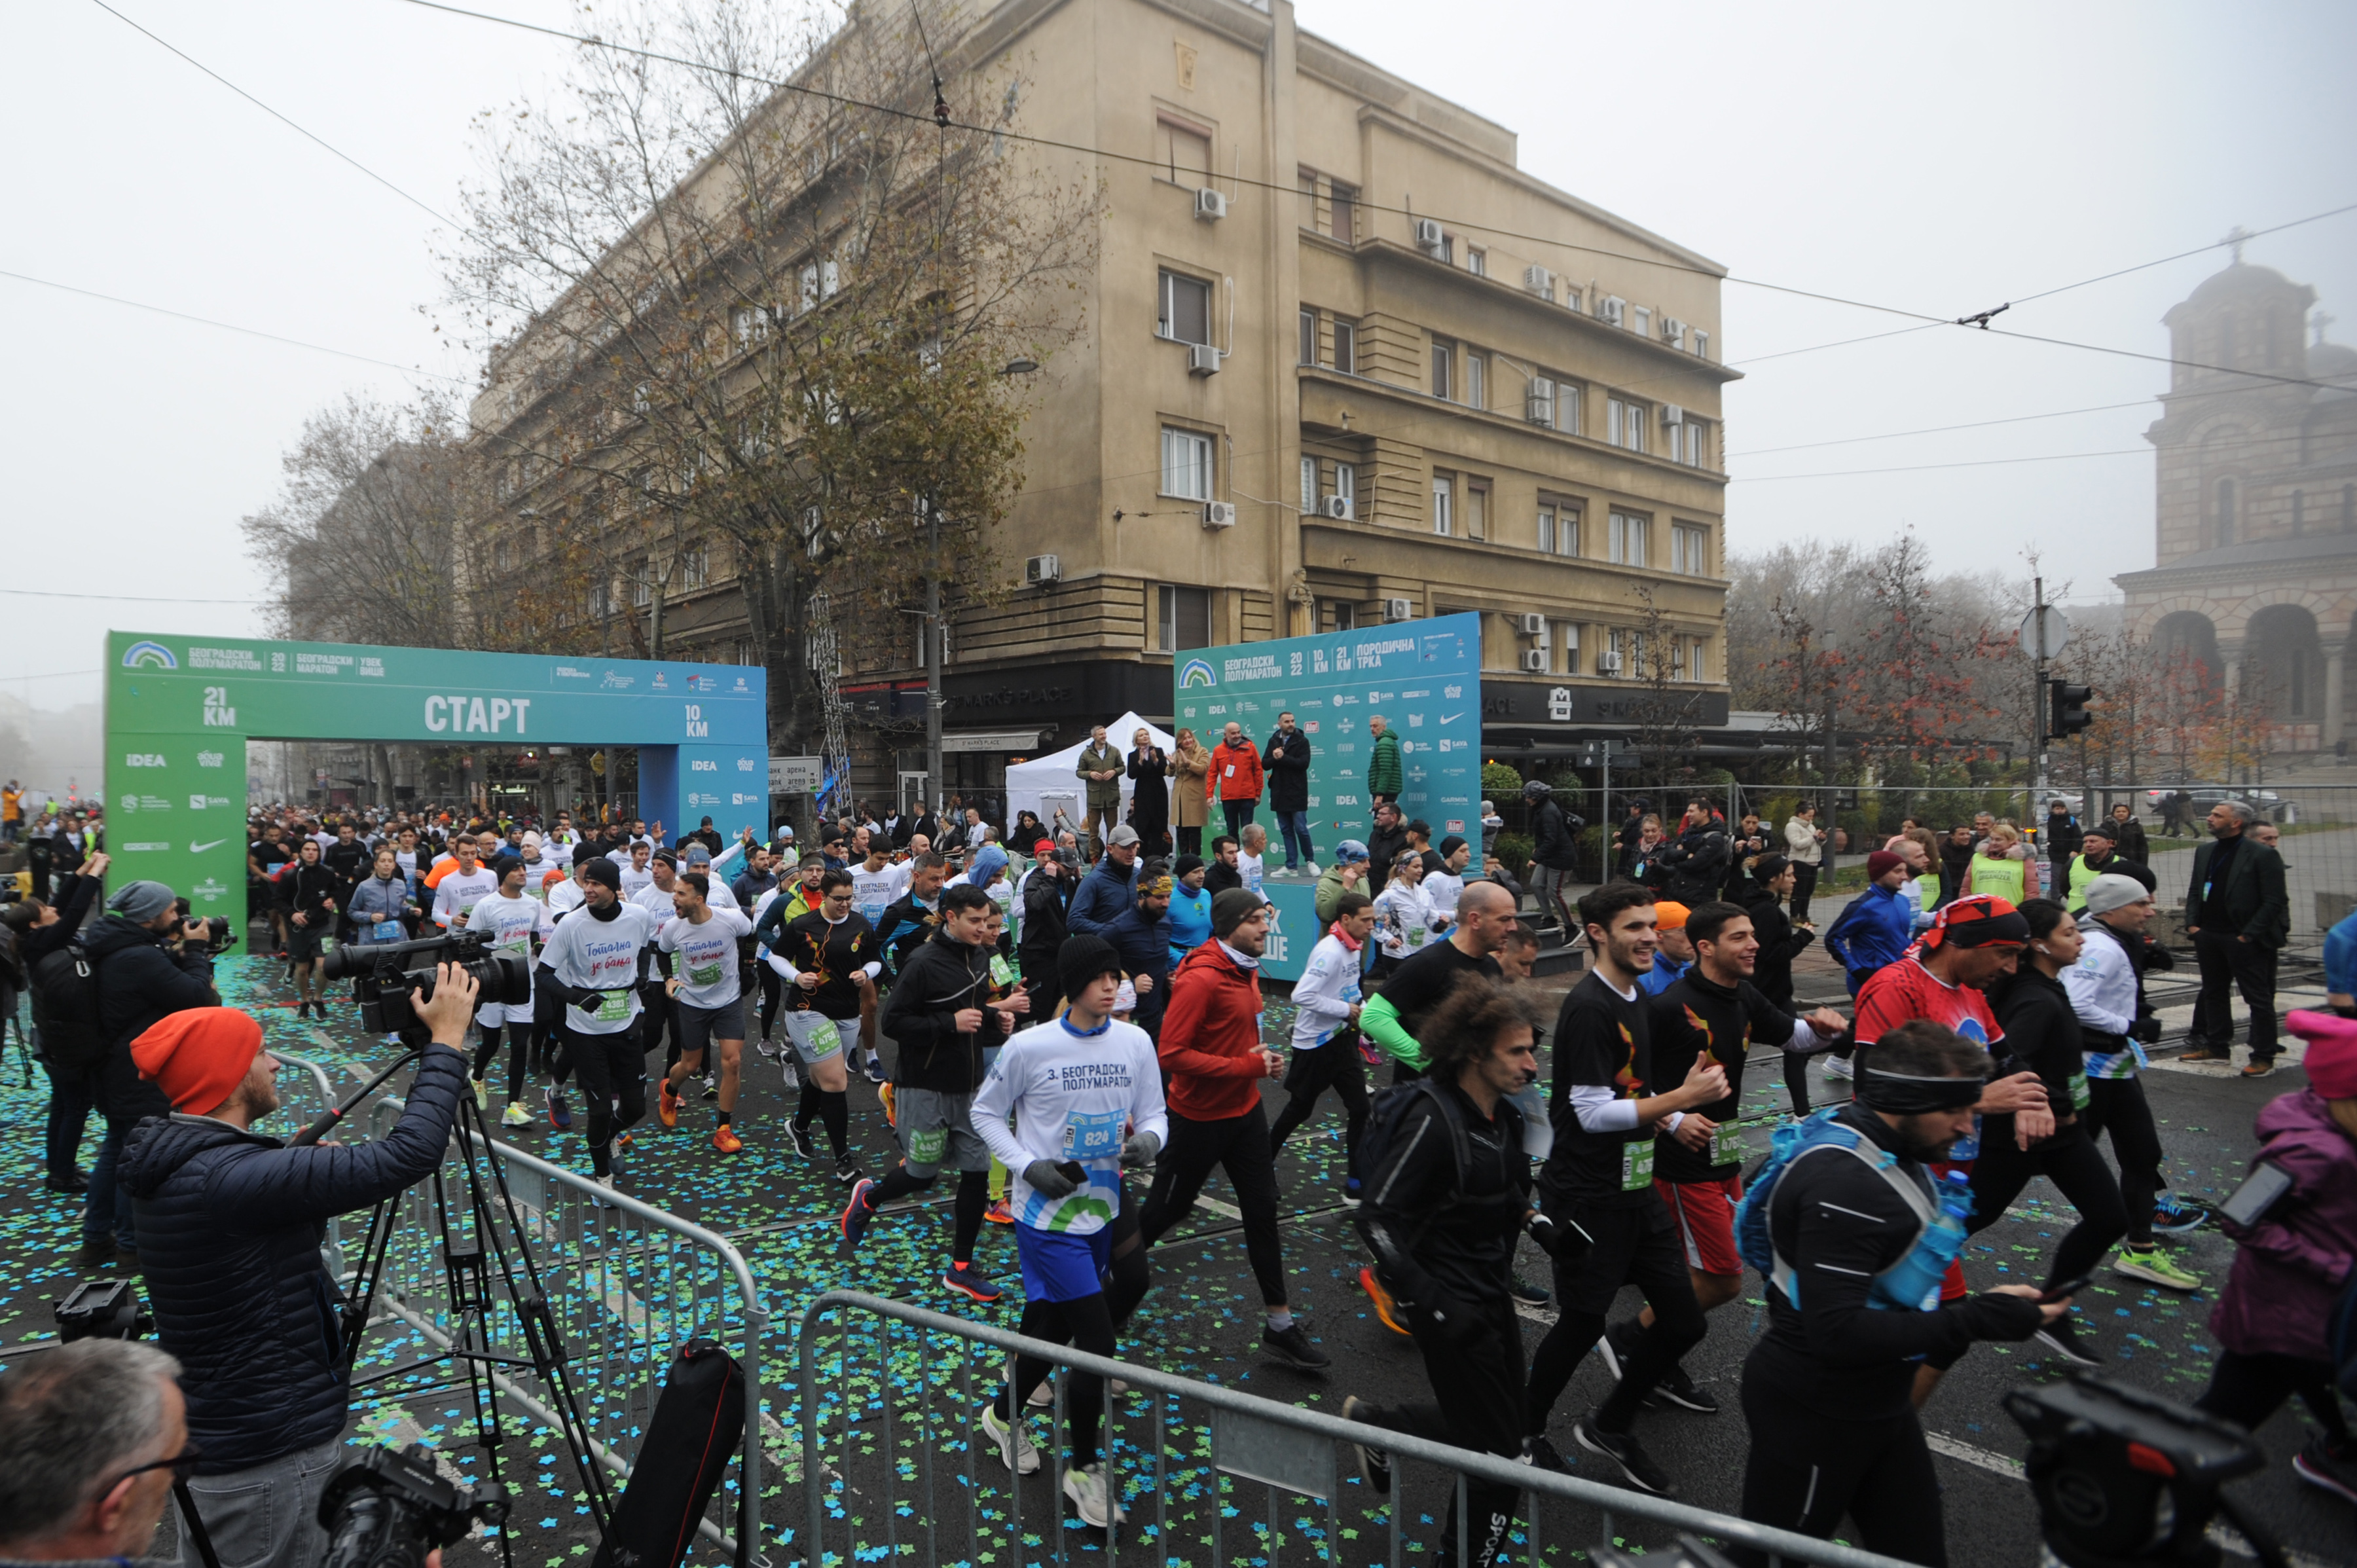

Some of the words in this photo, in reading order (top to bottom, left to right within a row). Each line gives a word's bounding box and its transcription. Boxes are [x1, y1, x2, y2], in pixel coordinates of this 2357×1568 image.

[189, 647, 254, 660] БЕОГРАДСКИ
[1337, 646, 1347, 659] 21
[1357, 638, 1415, 657] ПОРОДИЧНА
[271, 652, 285, 662] 20
[296, 653, 353, 665] БЕОГРАДСКИ
[359, 657, 382, 666] УВЕК
[1290, 652, 1303, 664] 20
[1313, 649, 1323, 661] 10
[189, 657, 261, 670] ПОЛУМАРАТОН
[271, 662, 285, 672] 22
[296, 663, 338, 674] МАРАТОН
[1225, 655, 1274, 670] БЕОГРАДСКИ
[1357, 655, 1382, 669] ТРКА
[359, 666, 384, 676] ВИШЕ
[1225, 666, 1282, 682] ПОЛУМАРАТОН
[1291, 664, 1303, 676] 22
[204, 687, 227, 706] 21
[1019, 687, 1074, 703] PLACE
[425, 695, 530, 733] СТАРТ
[685, 704, 701, 720] 10
[591, 960, 601, 976] је
[604, 956, 630, 969] бања
[606, 998, 625, 1009] 4383
[818, 1030, 836, 1046] 4758
[1048, 1069, 1059, 1080] 3.
[1062, 1064, 1126, 1079] БЕОГРАДСКИ
[1063, 1076, 1132, 1091] ПОЛУМАРАТОН
[1084, 1131, 1109, 1146] 824
[919, 1139, 942, 1152] 4427
[1477, 1512, 1507, 1568] SPORT
